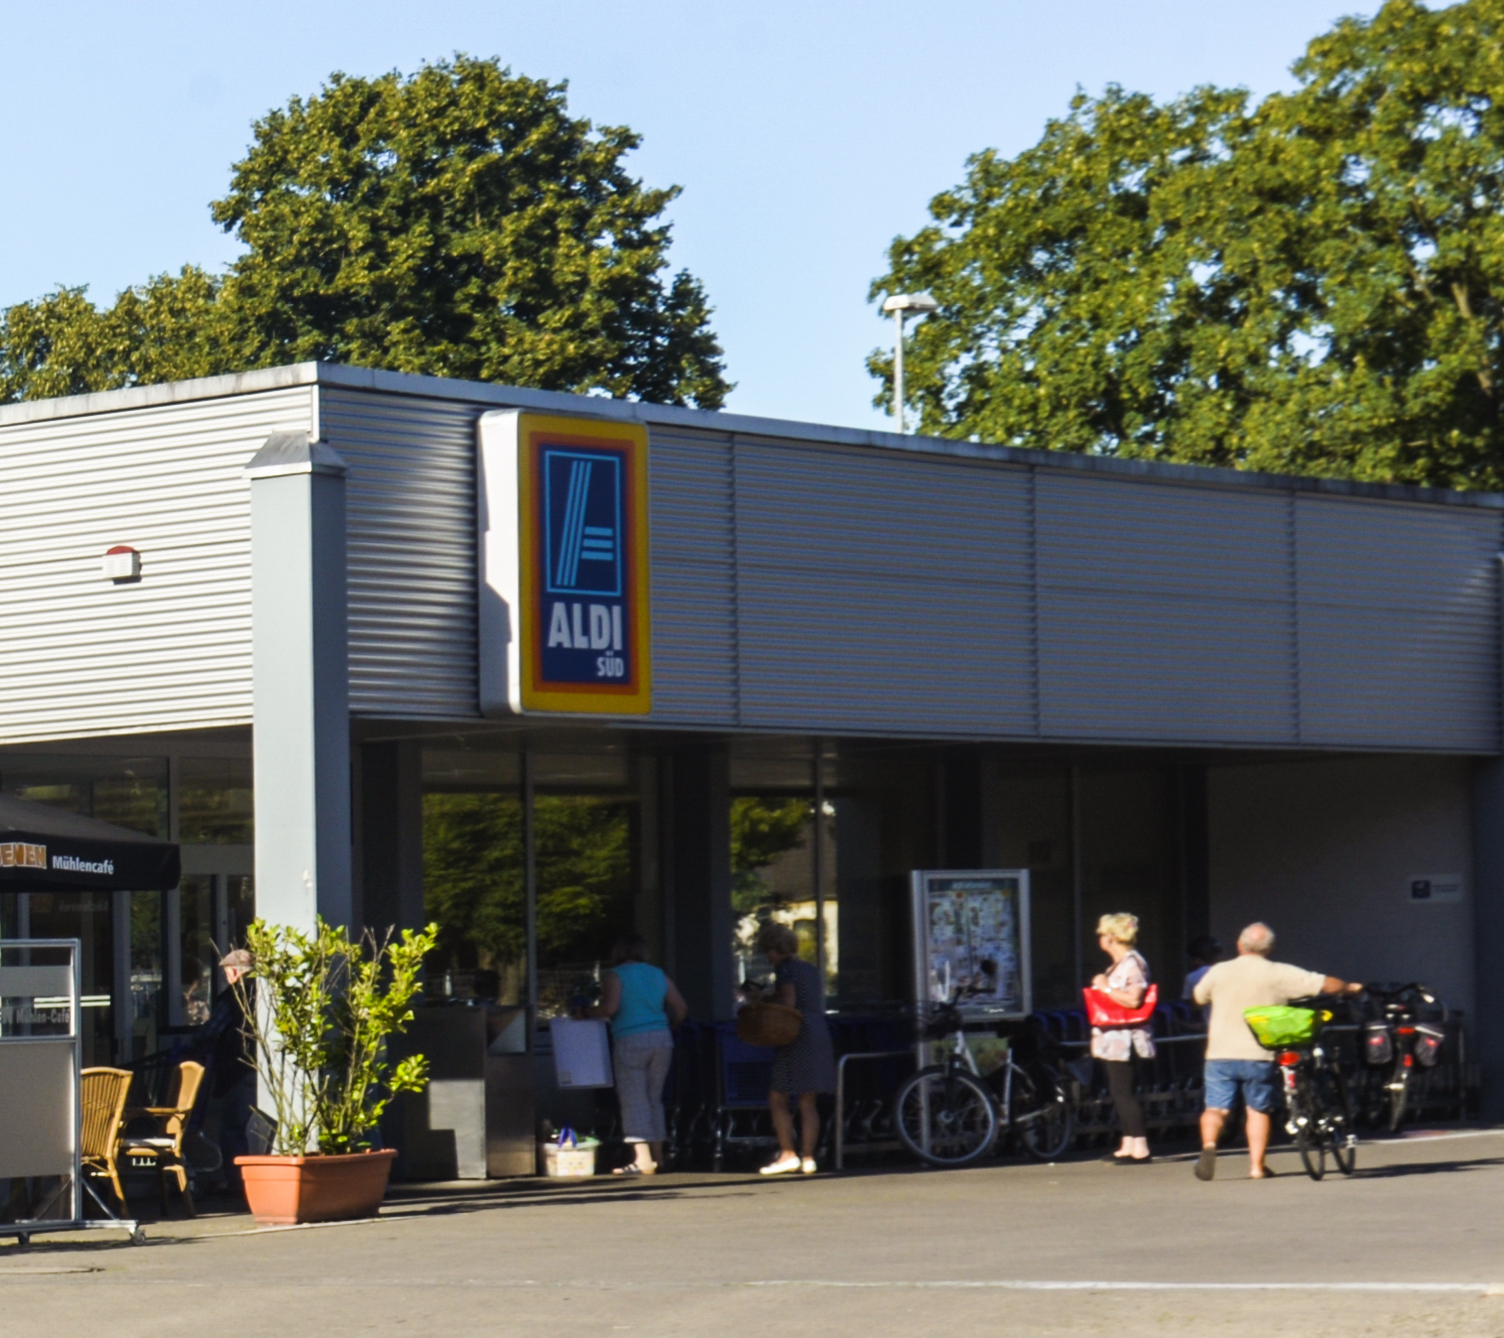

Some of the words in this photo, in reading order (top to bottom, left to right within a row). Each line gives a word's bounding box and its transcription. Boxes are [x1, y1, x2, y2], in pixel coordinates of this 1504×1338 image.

[548, 602, 622, 651] ALDI
[597, 650, 624, 677] SÜD
[52, 855, 114, 874] Mühlencafé
